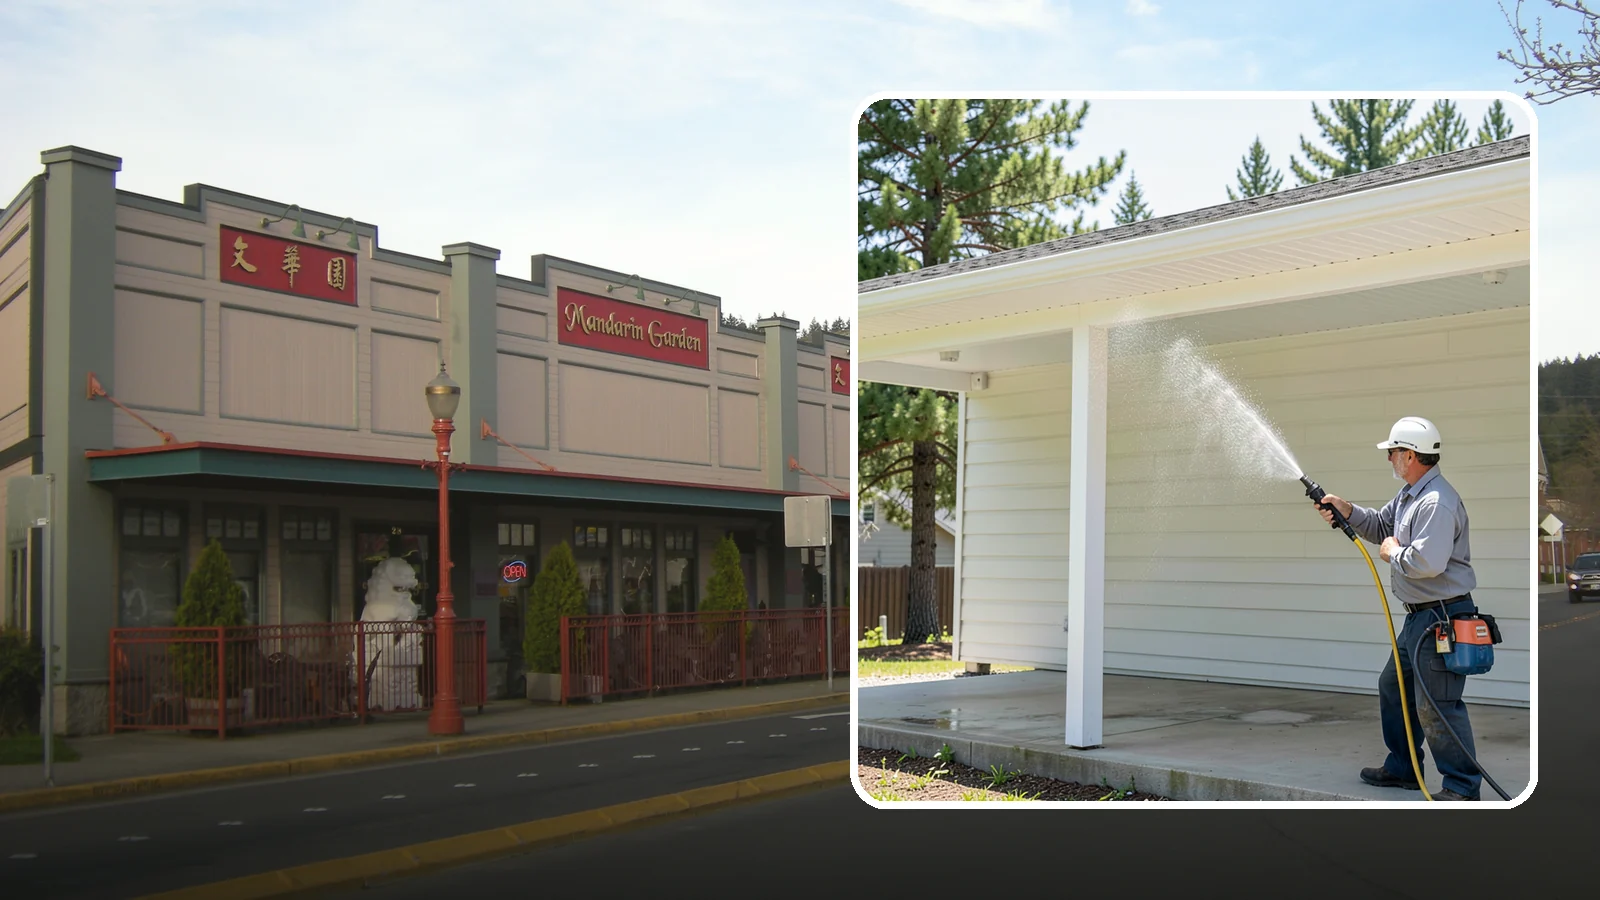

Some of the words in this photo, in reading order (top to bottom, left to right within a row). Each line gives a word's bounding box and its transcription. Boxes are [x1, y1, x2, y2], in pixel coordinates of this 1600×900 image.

[231, 236, 346, 290] 文華園
[564, 302, 644, 341] Mandarin
[647, 320, 702, 352] Garden
[503, 565, 527, 578] OPEN
